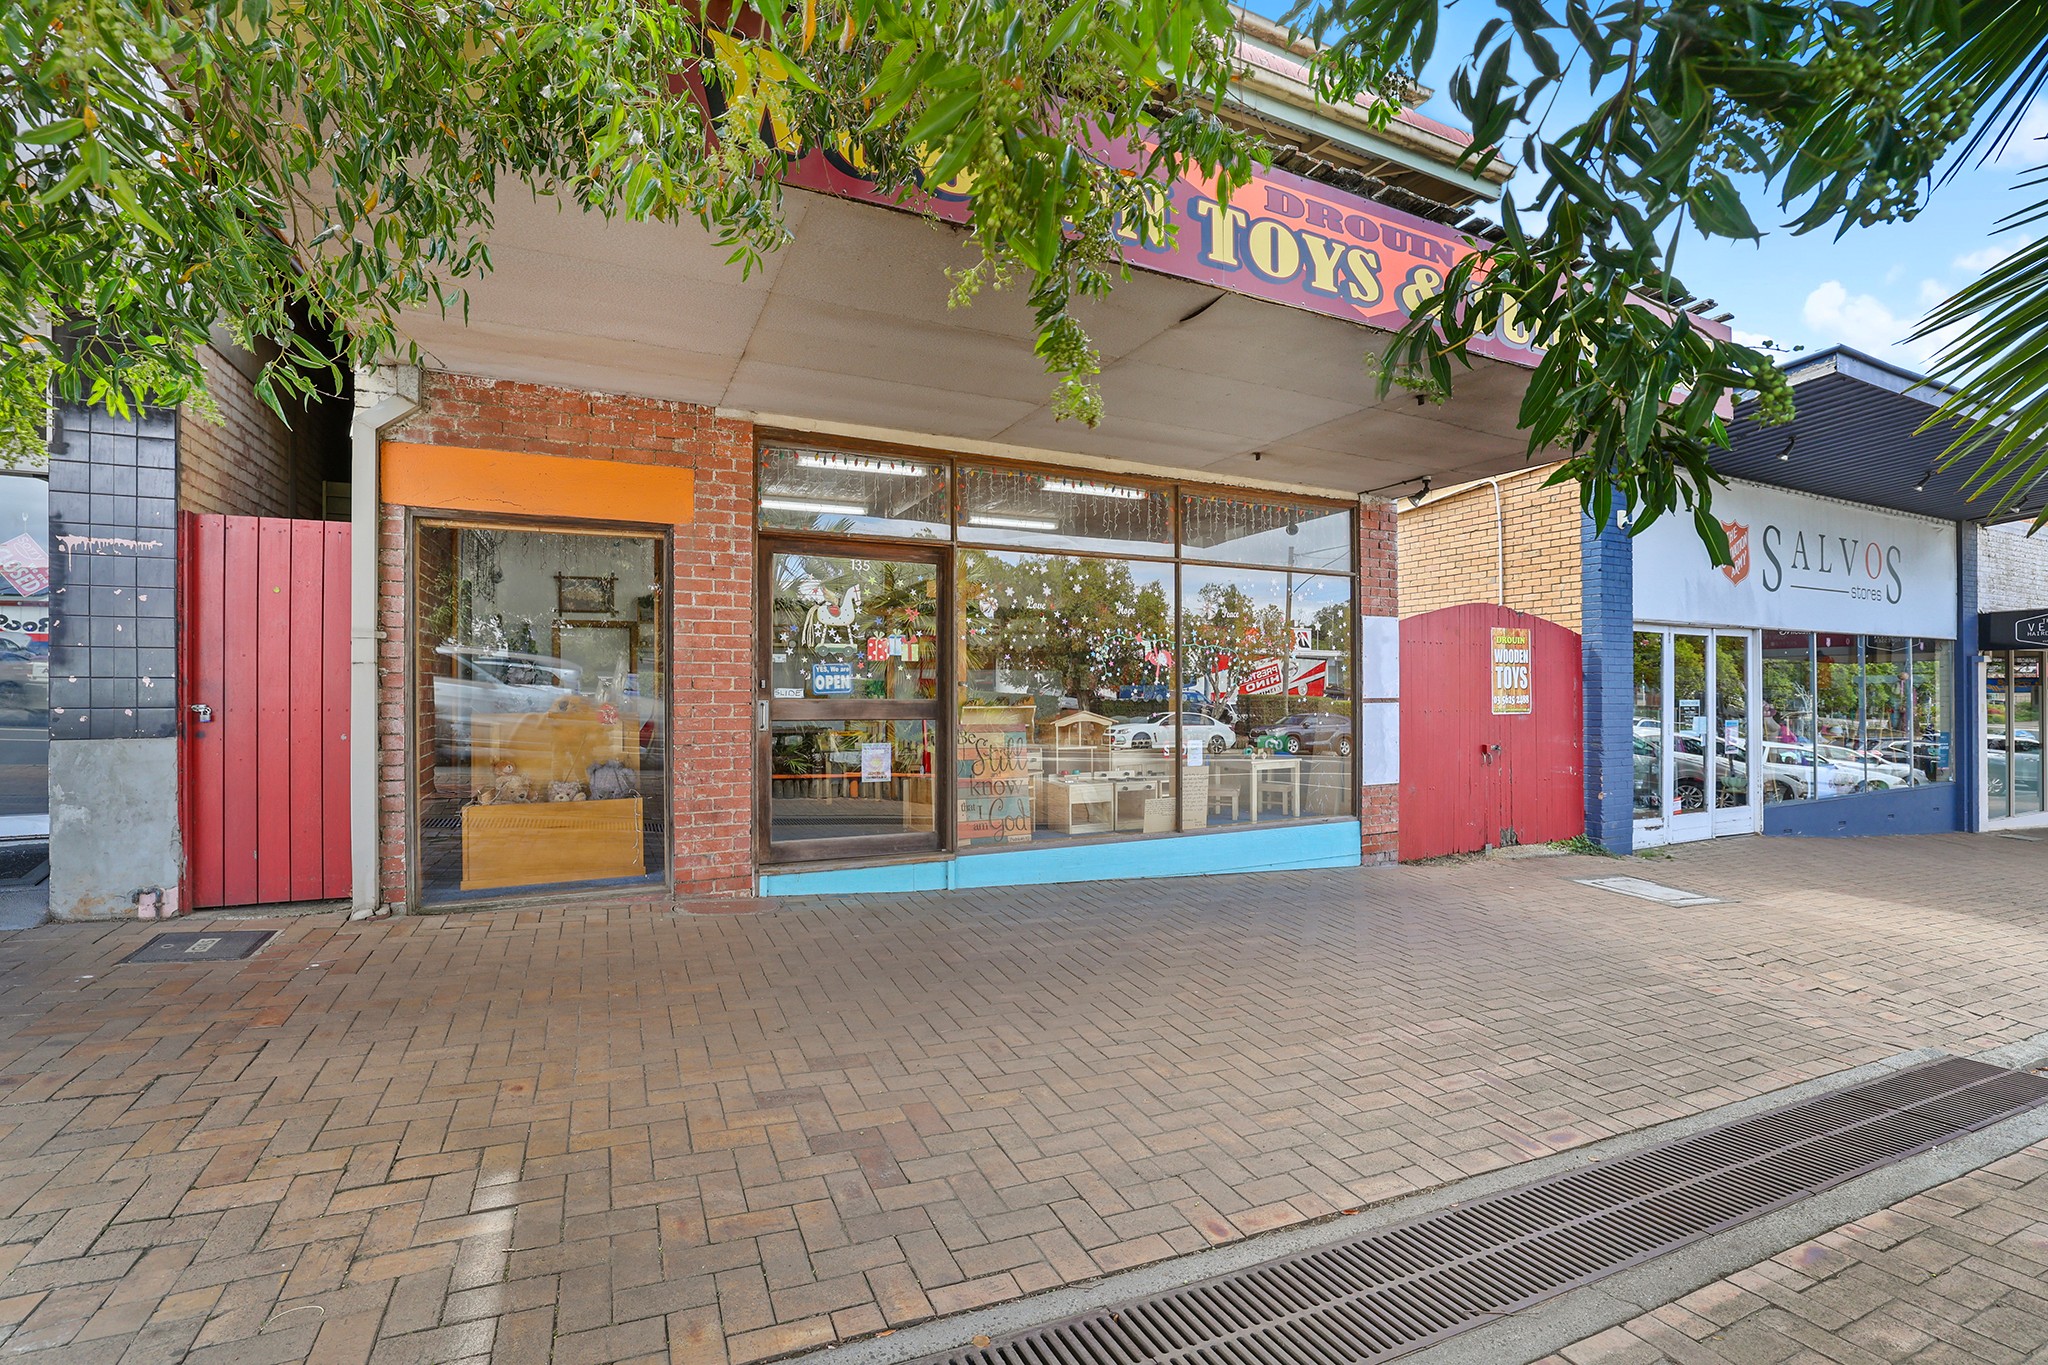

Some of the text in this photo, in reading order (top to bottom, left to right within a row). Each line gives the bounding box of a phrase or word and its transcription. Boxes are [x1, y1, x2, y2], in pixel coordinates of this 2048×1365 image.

[1264, 184, 1454, 267] DROUIN
[1195, 198, 1381, 303] TOYS
[850, 559, 870, 571] 135
[1762, 524, 1902, 605] SALVOS
[1850, 586, 1882, 601] stores
[1026, 598, 1047, 610] Love
[1116, 605, 1136, 617] Hope
[1221, 608, 1240, 618] Peace
[1496, 636, 1525, 645] DROUIN
[1494, 648, 1529, 664] WOODEN
[815, 674, 851, 690] OPEN
[1495, 666, 1528, 689] TOYS
[774, 689, 802, 697] SLIDE
[1493, 695, 1500, 704] 03
[957, 731, 976, 745] Be
[971, 737, 1028, 776] Still
[969, 774, 1024, 796] know
[961, 802, 983, 819] that I
[973, 798, 1030, 843] am God
